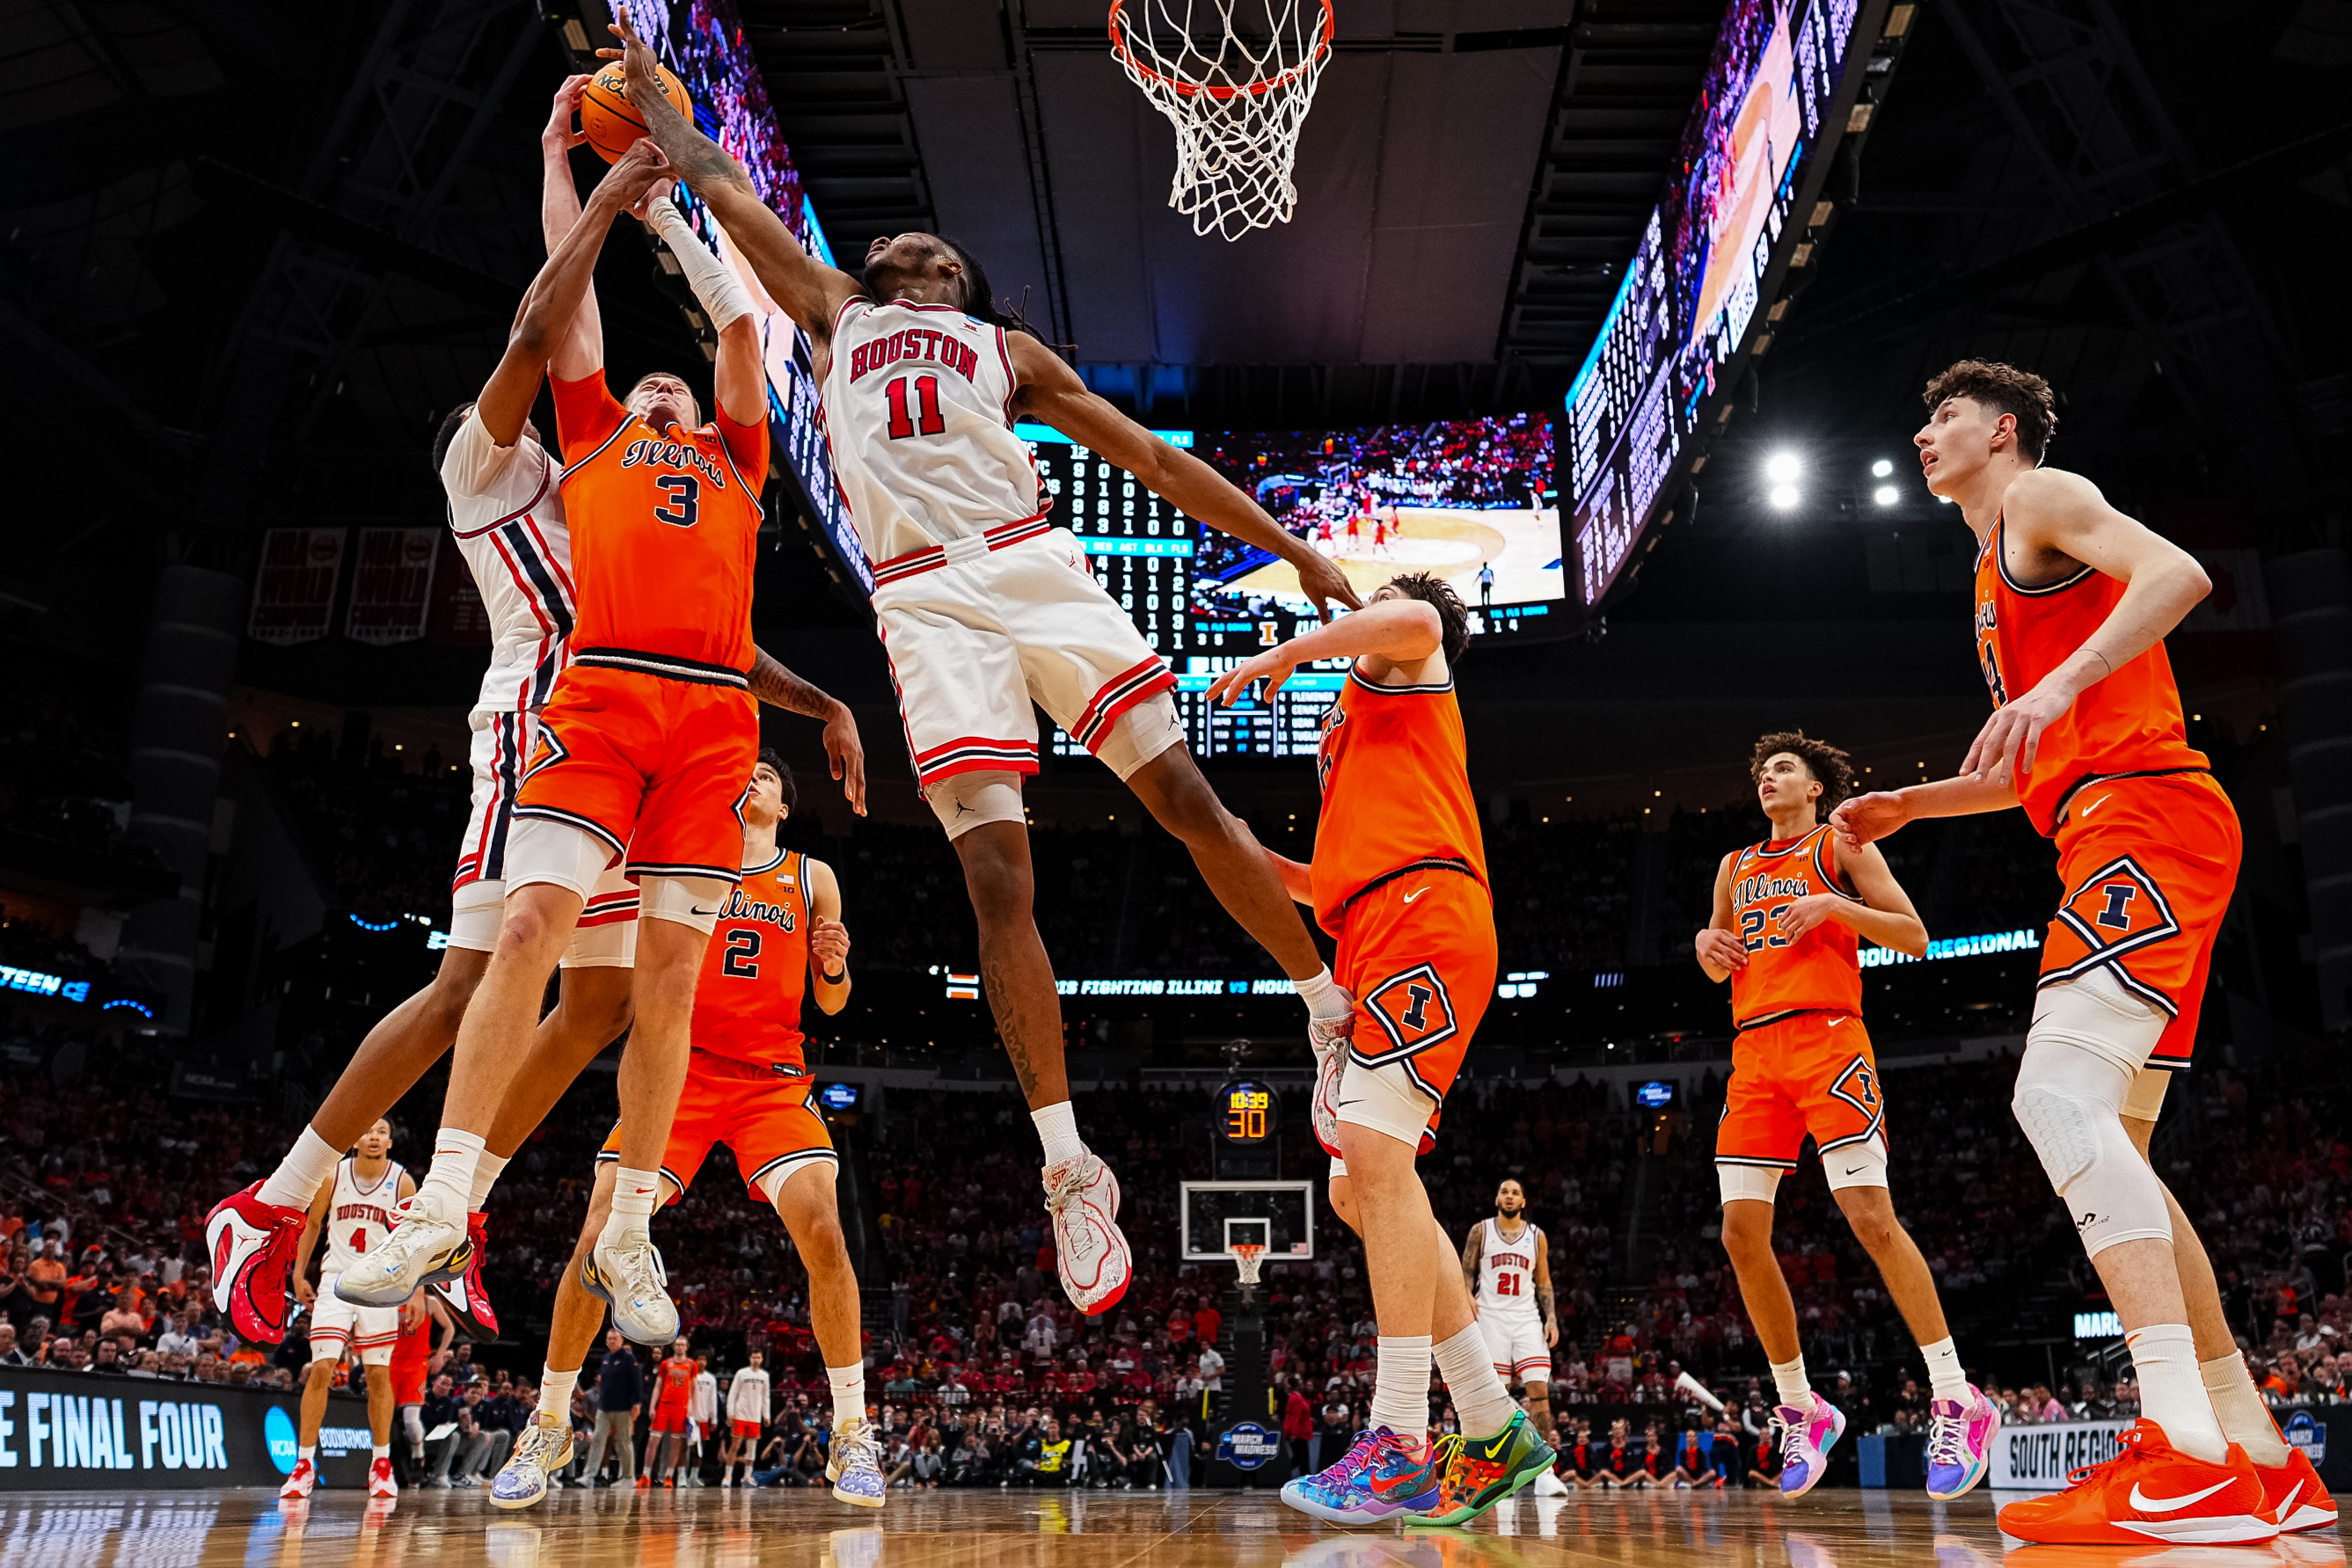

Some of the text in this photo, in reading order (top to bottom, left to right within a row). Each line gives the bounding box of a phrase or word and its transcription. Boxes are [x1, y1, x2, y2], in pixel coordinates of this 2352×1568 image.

[851, 329, 979, 385] HOUSTON
[885, 376, 946, 441] 11
[1070, 444, 1090, 460] 12
[654, 474, 700, 529] 3
[1099, 481, 1109, 497] 1
[1122, 483, 1136, 499] 0
[1122, 500, 1135, 516] 2
[1148, 501, 1159, 517] 1
[1071, 517, 1084, 533] 2
[1123, 519, 1134, 535] 1
[1147, 520, 1160, 536] 0
[1172, 520, 1185, 536] 0
[1096, 555, 1184, 573] 4 1 0 1
[1122, 574, 1133, 591] 1
[1148, 575, 1158, 592] 1
[1172, 576, 1185, 592] 2
[1146, 594, 1159, 611] 0
[1172, 594, 1185, 611] 0
[1147, 613, 1158, 630] 1
[1172, 632, 1184, 650] 1
[1734, 872, 1809, 915] Illinois
[718, 888, 796, 934] linois
[2095, 884, 2137, 932] I
[1740, 907, 1791, 954] 23
[722, 928, 763, 980] 2
[1858, 929, 2040, 969] SOUT REGIONAL
[0, 966, 62, 993] TEEN
[1081, 981, 1164, 995] FIGHTING
[1166, 981, 1223, 995] ILLINI
[1229, 981, 1249, 995] VS
[1400, 983, 1433, 1032] I
[1231, 1092, 1268, 1110] 10:39
[1856, 1071, 1878, 1106] I
[1228, 1109, 1266, 1138] 30
[337, 1204, 387, 1226] HOUSTON
[348, 1228, 366, 1253] 4
[1491, 1252, 1530, 1272] HOUSTON
[1497, 1273, 1520, 1296] 21
[2074, 1311, 2126, 1338] MARC
[27, 1392, 134, 1470] FINAL
[139, 1400, 229, 1470] FOUR
[318, 1427, 374, 1450] BODYARMOR
[2010, 1433, 2060, 1479] SOUTH
